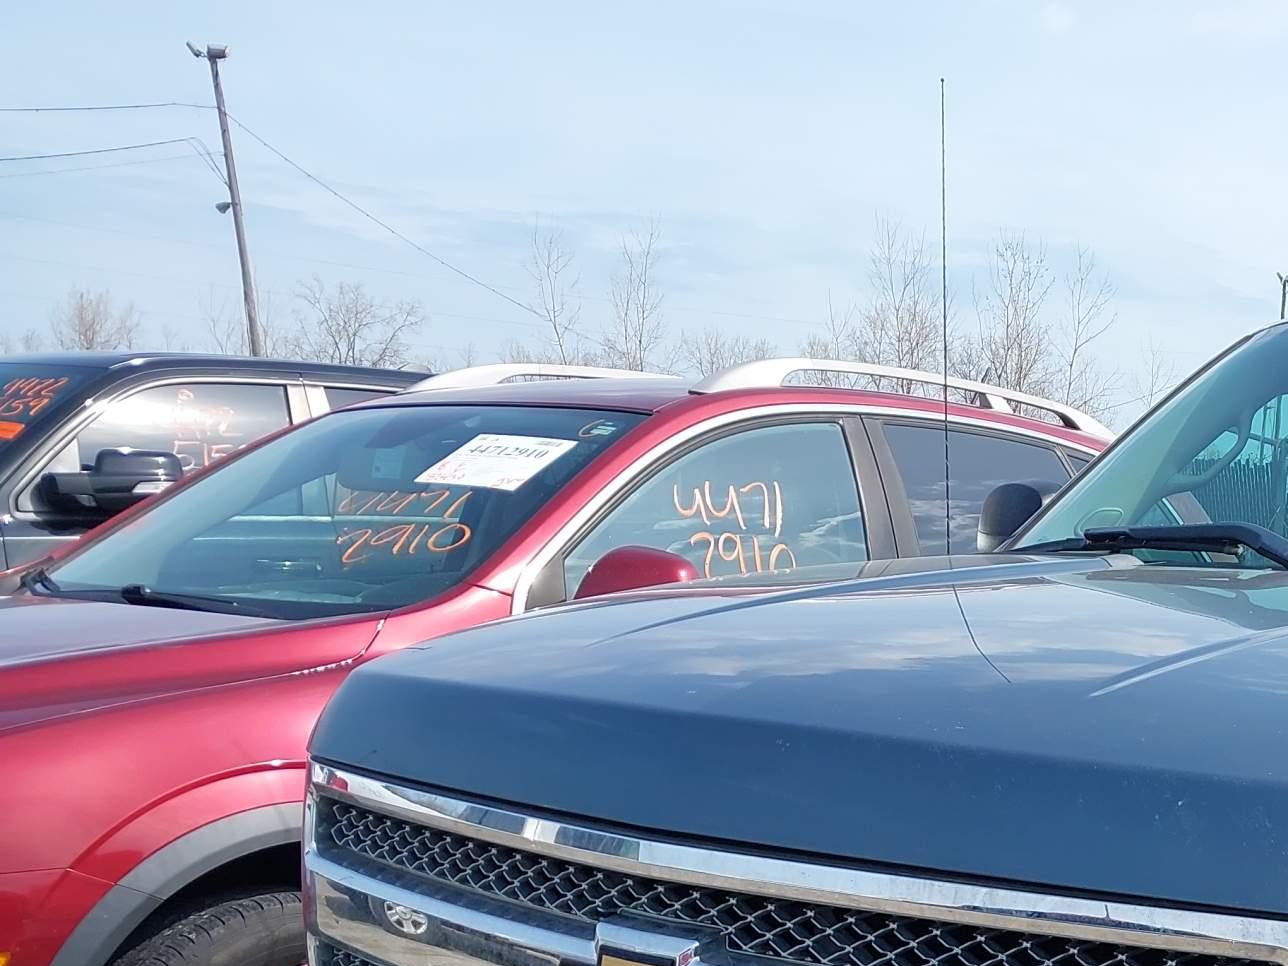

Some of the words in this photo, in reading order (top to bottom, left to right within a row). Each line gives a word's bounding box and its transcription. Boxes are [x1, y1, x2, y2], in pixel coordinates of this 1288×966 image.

[470, 444, 550, 459] 44712910
[336, 488, 473, 520] 4471
[673, 480, 783, 538] 4471
[337, 523, 472, 564] 2910
